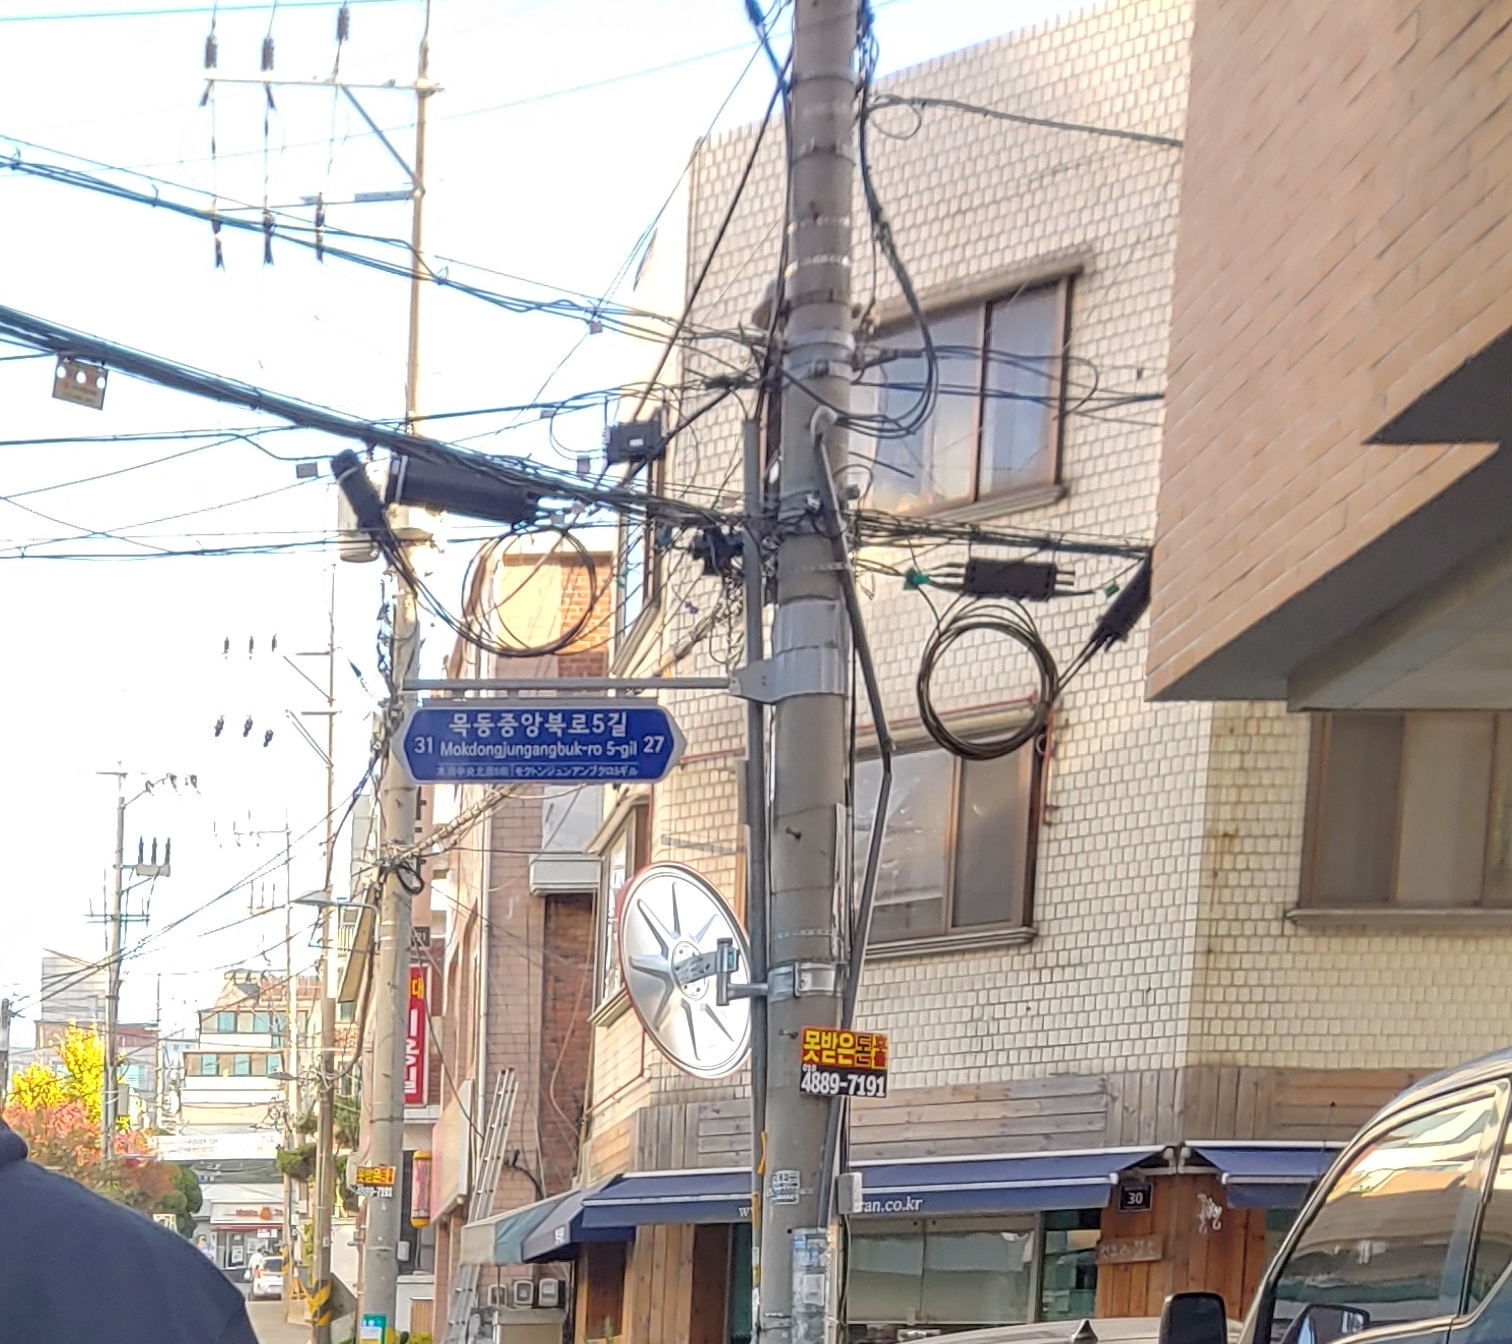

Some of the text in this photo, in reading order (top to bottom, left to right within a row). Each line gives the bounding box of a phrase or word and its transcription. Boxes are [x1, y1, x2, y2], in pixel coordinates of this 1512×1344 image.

[448, 712, 628, 738] 목동중앙북로5길
[414, 736, 434, 754] 31
[440, 740, 638, 759] Mokdongjungangbuk-ro 5-gil
[643, 736, 665, 754] 27
[800, 1070, 886, 1097] 4889-7191
[1127, 1192, 1144, 1205] 30
